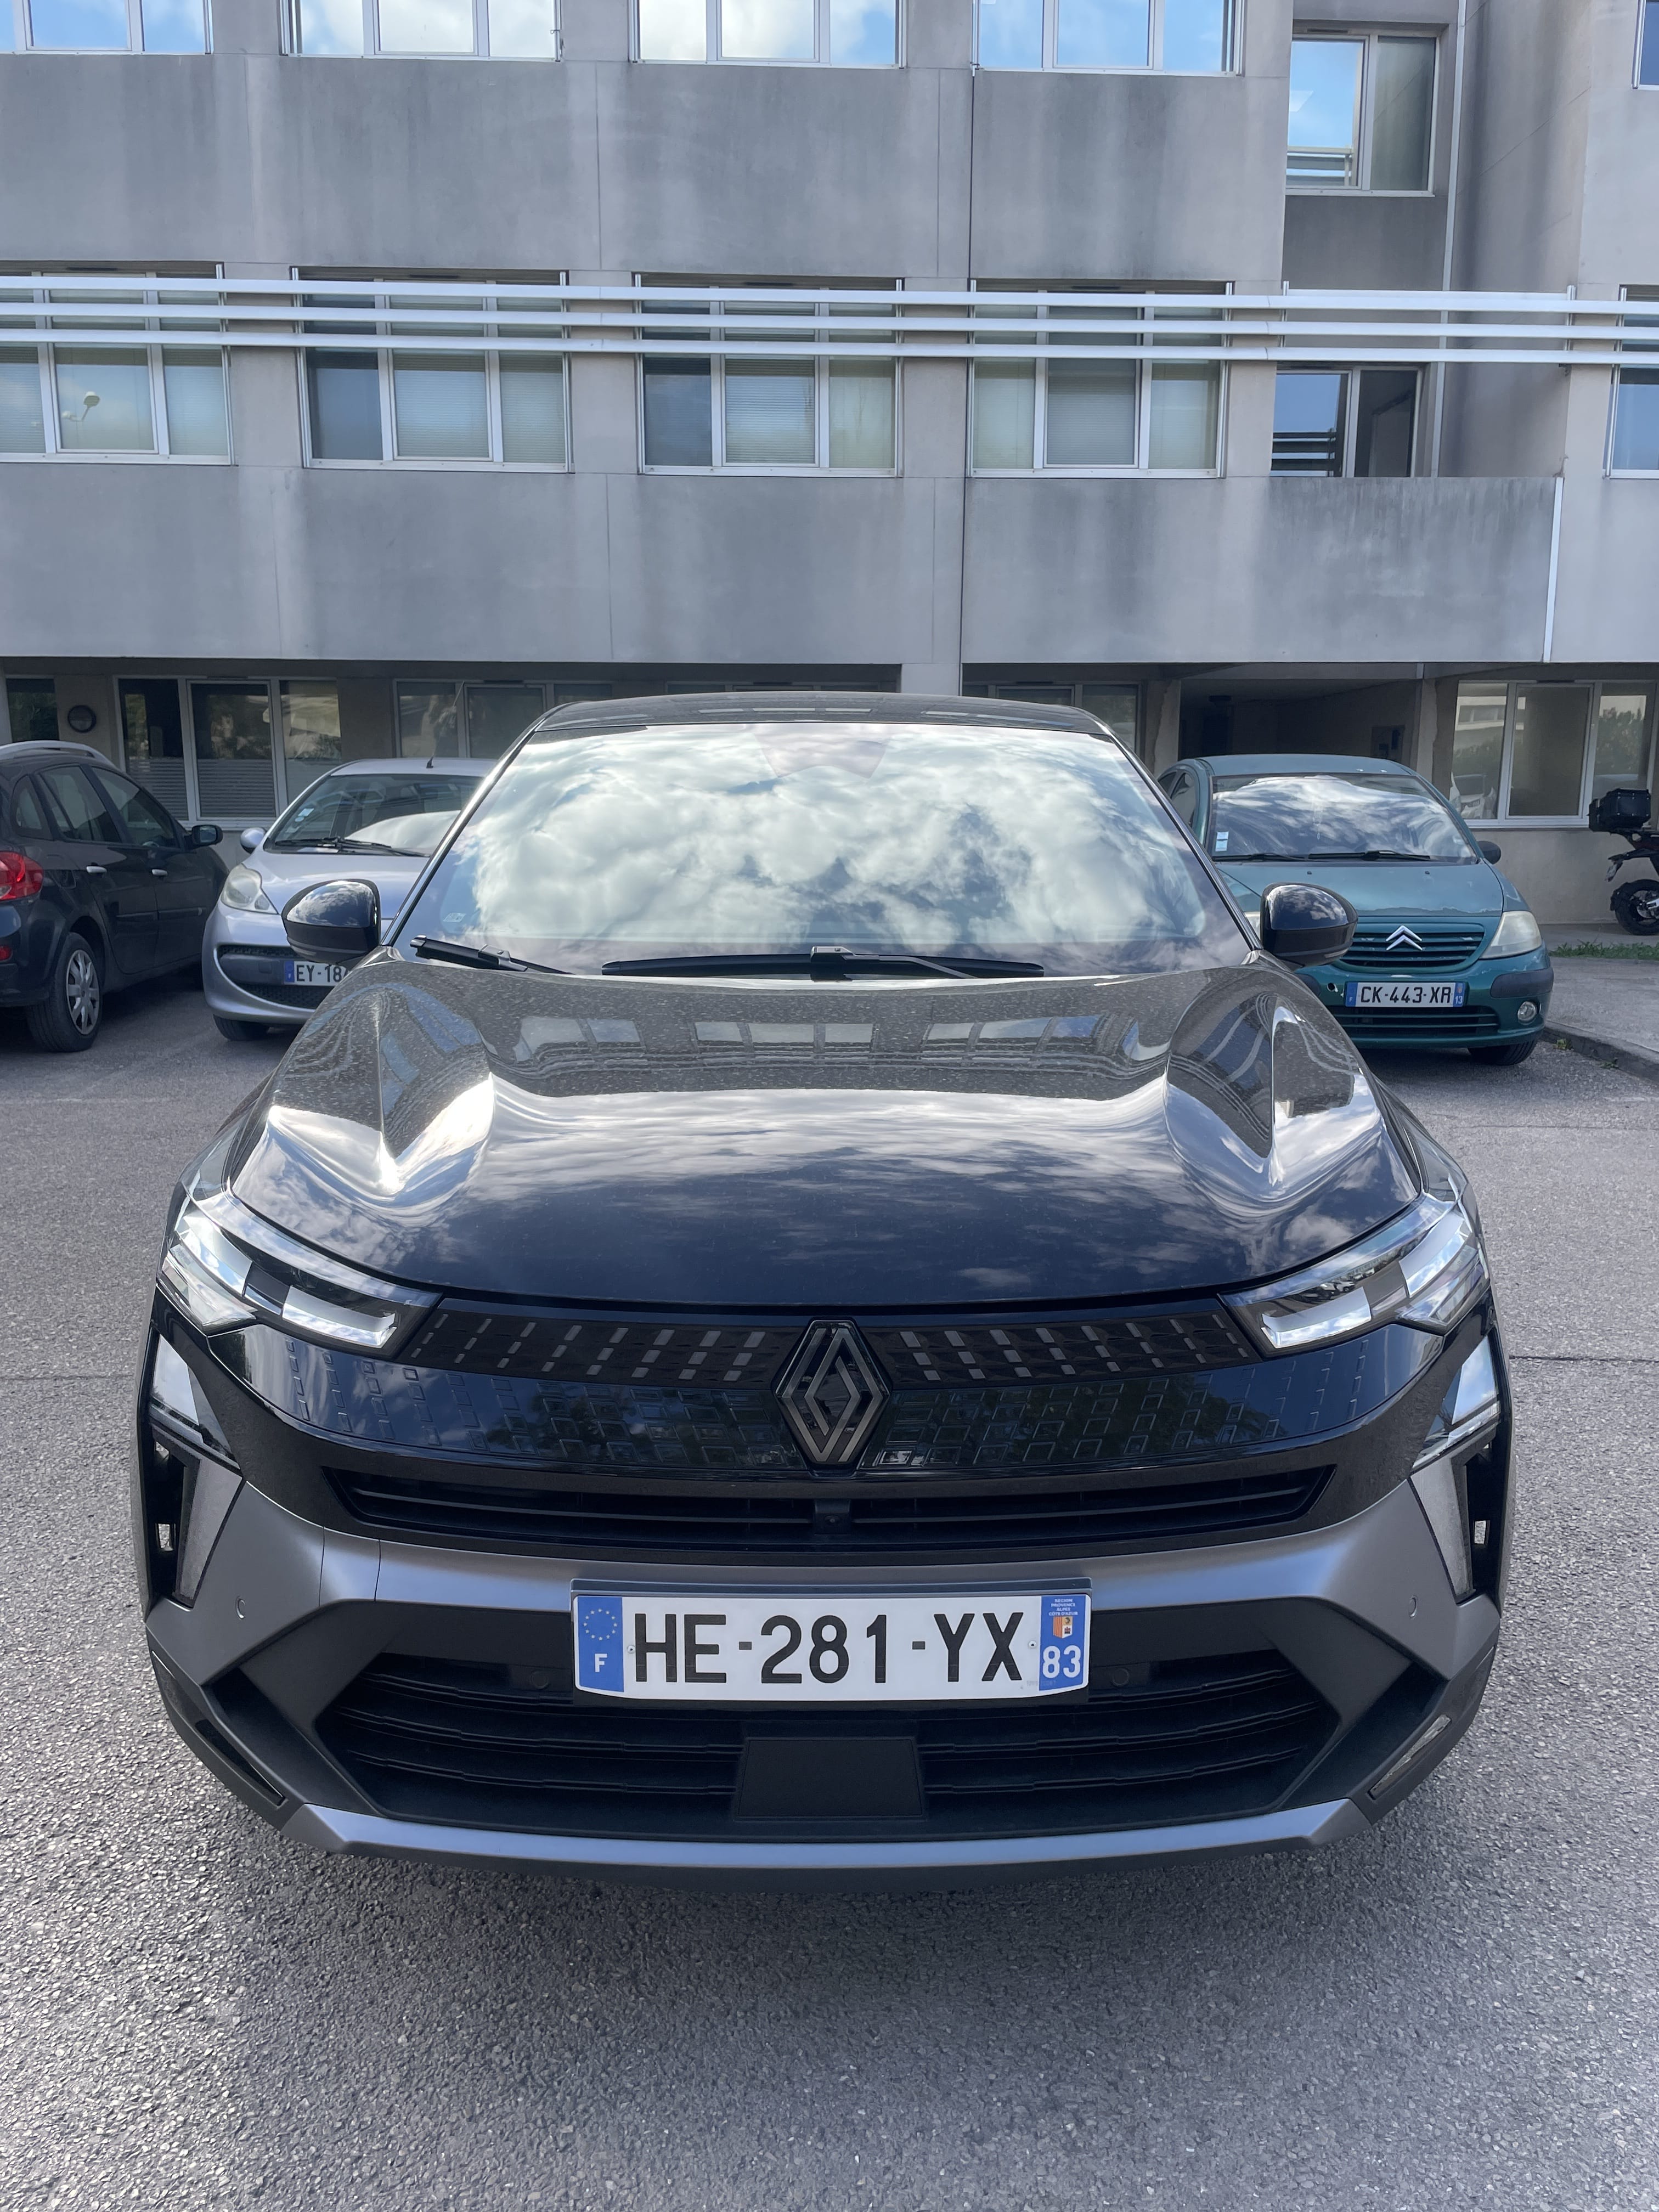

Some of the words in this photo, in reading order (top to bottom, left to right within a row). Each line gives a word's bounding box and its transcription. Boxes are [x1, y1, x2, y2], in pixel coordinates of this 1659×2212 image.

[296, 964, 347, 982] EY-18
[1361, 986, 1452, 1003] CK-443-XR
[1455, 996, 1463, 1004] 13
[635, 1612, 1024, 1684] HE-281-YX
[594, 1654, 607, 1673] F
[1042, 1645, 1081, 1679] 83
